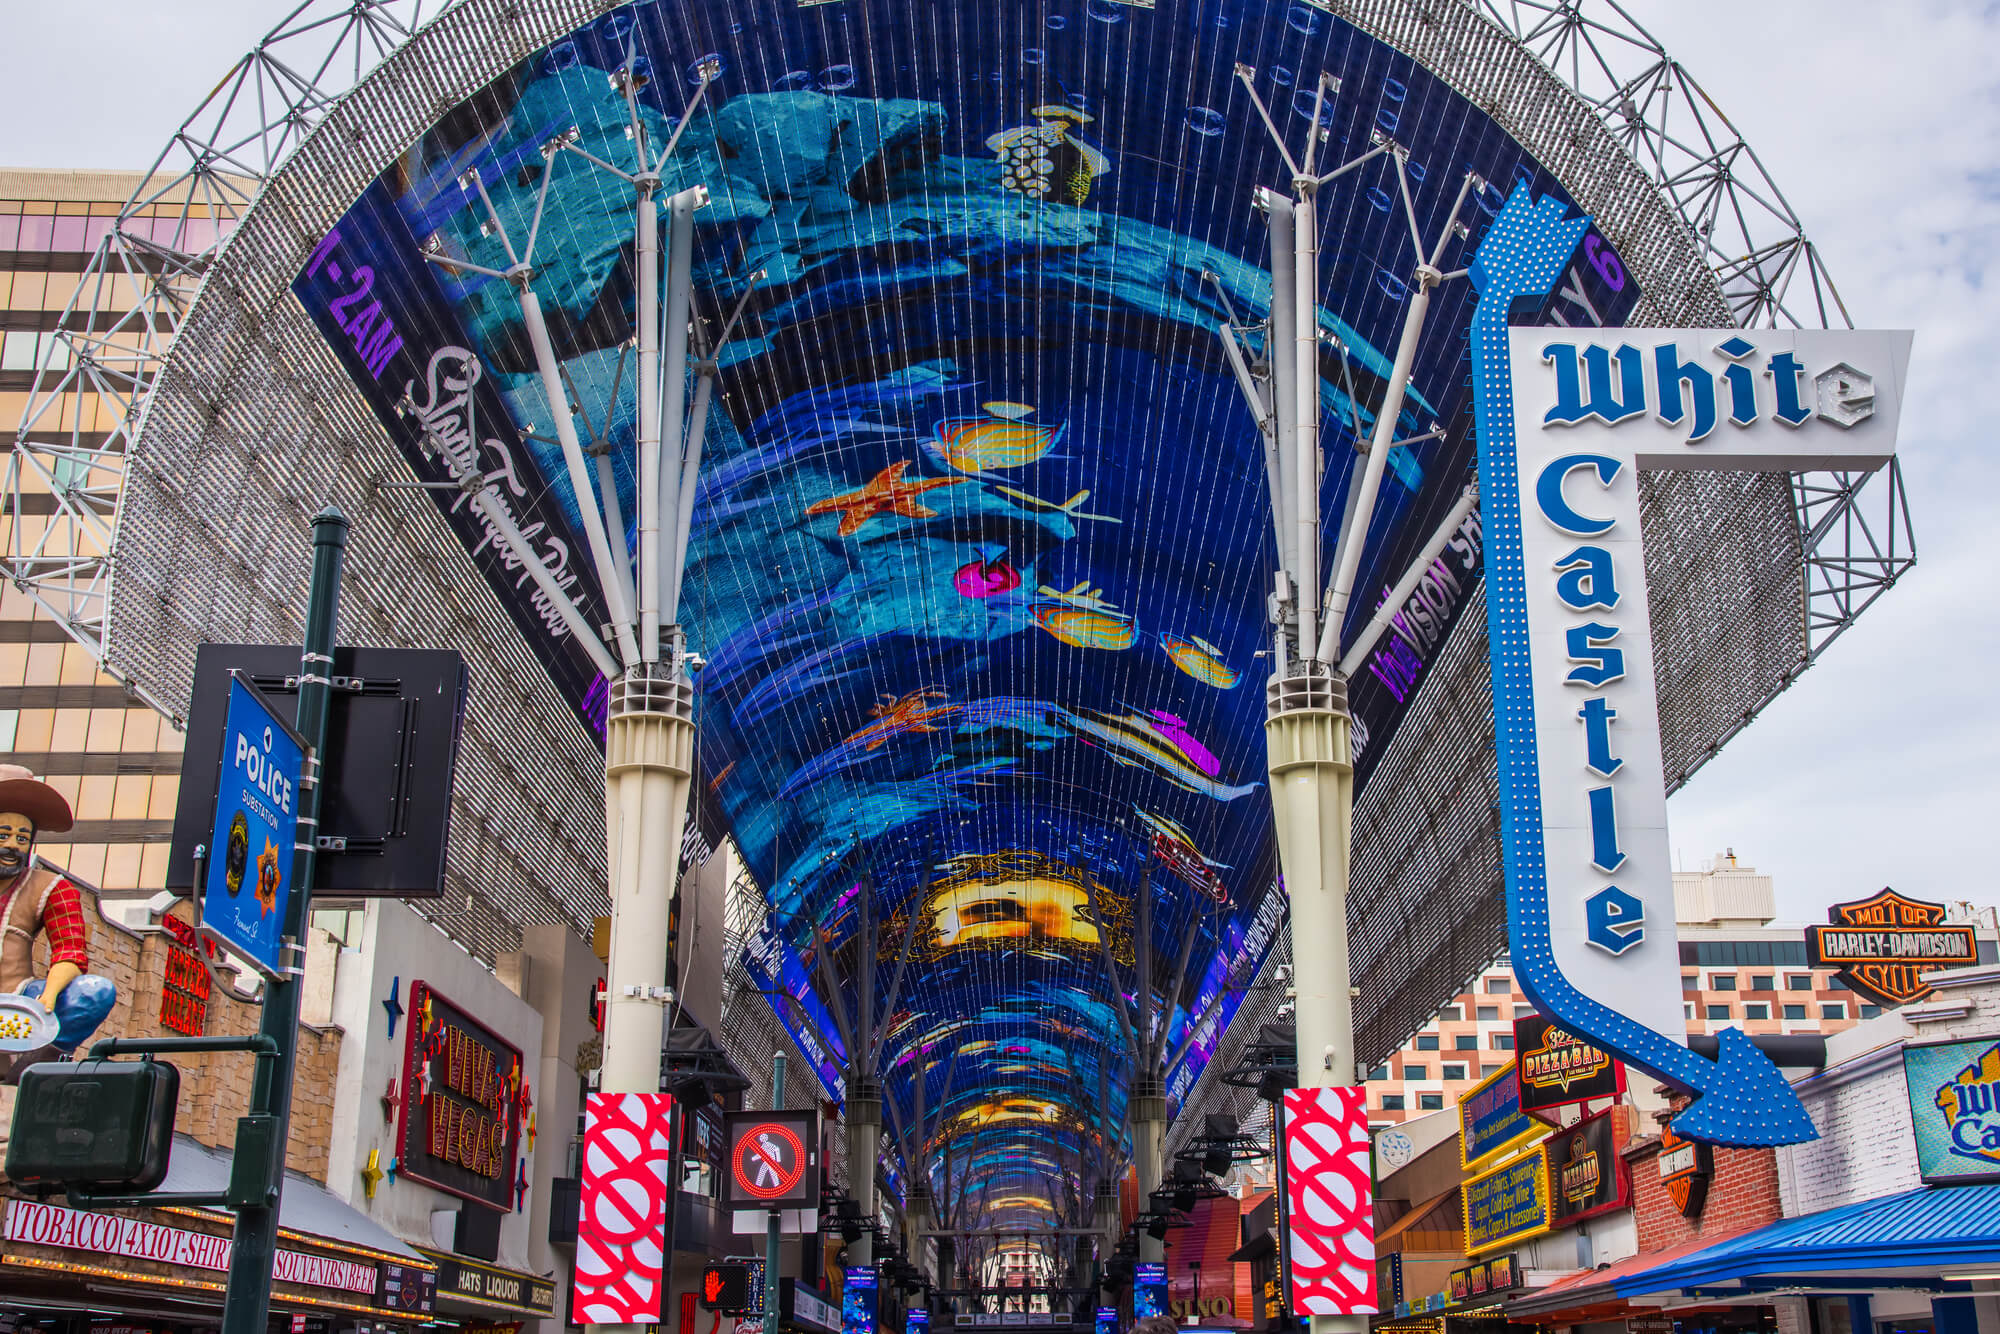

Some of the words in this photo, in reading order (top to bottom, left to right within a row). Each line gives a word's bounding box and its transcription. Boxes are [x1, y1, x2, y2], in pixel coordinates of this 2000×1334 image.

[1541, 335, 1876, 443] White
[1535, 452, 1647, 957] Castle
[235, 731, 292, 815] POLICE
[241, 788, 279, 831] SUBSTATION
[1855, 899, 1932, 926] MOTOR
[1825, 932, 1968, 957] HARLEY-DAVIDSON
[449, 1024, 498, 1112] VIVA
[1526, 1050, 1570, 1077] PIZZA
[1572, 1045, 1604, 1067] BAR
[432, 1091, 503, 1180] VEGAS
[17, 1203, 120, 1251] TOBACCO
[274, 1250, 345, 1287] SOUVENIRS
[347, 1263, 376, 1294] BEER
[458, 1269, 481, 1292] HATS
[486, 1275, 519, 1300] LIQUOR
